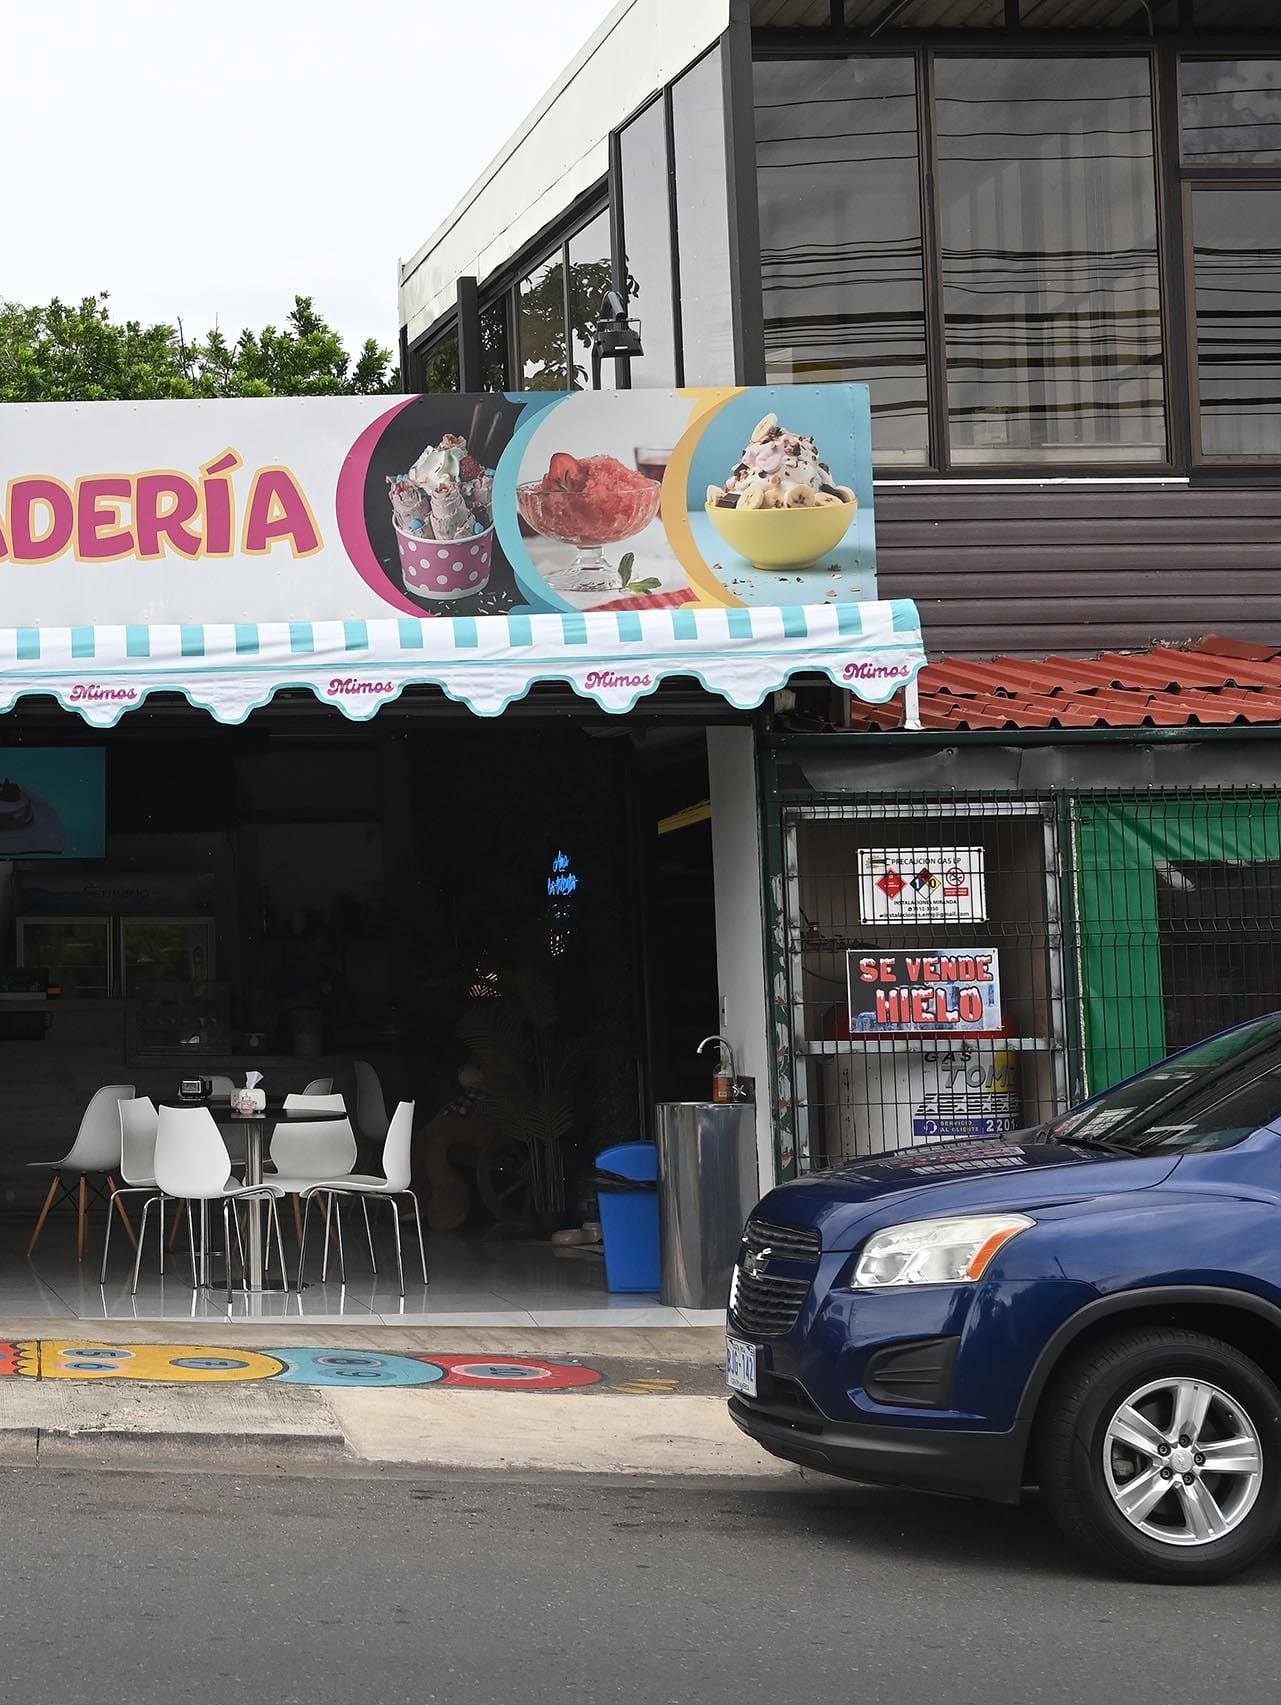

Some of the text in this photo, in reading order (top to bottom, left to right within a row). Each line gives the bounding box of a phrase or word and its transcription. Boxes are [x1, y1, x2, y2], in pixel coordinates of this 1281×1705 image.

[586, 672, 651, 689] Mimos
[844, 663, 909, 681] Mimos
[70, 685, 137, 702] Mimos
[328, 679, 394, 696] Mimos
[859, 954, 994, 983] SE VENDE
[875, 986, 984, 1023] HIELO
[924, 1051, 972, 1063] GAS
